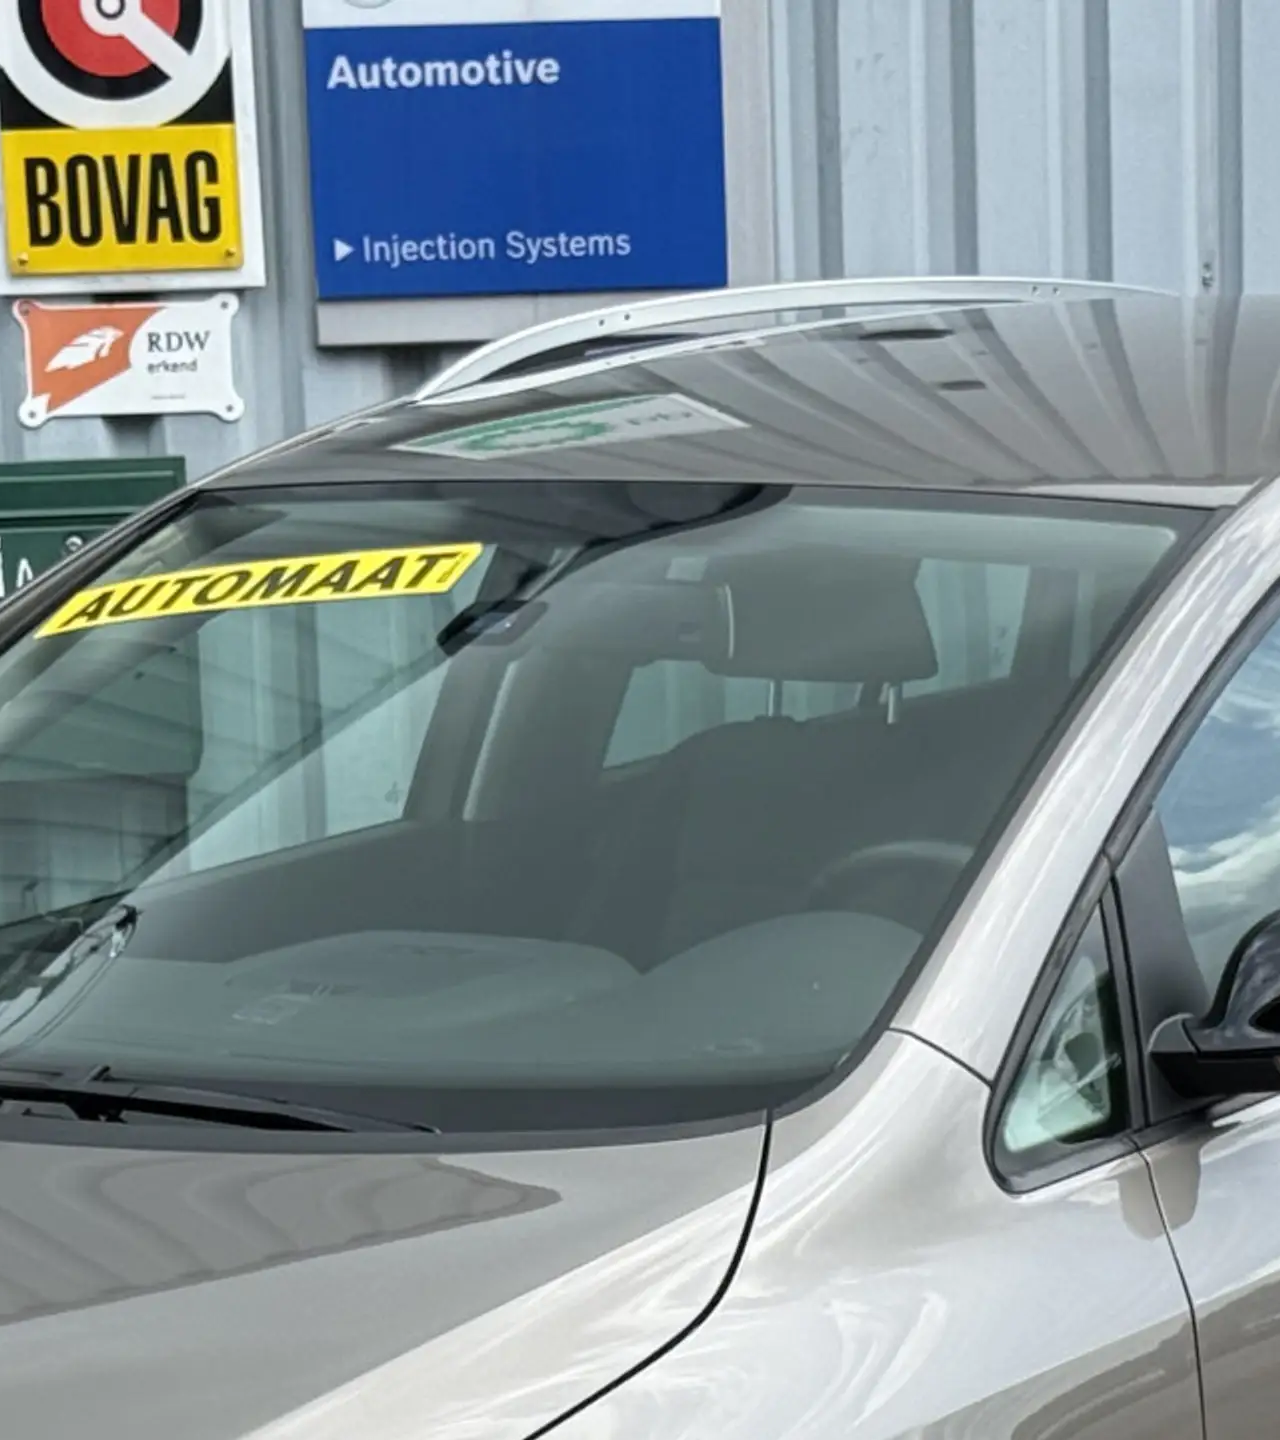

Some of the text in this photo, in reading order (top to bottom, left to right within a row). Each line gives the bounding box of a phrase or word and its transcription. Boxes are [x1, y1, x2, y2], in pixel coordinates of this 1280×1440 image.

[327, 51, 561, 90] Automotive
[23, 150, 222, 248] BOVAG
[363, 231, 631, 268] Injection Systems
[147, 330, 211, 352] RDW
[147, 358, 198, 374] erkend
[57, 551, 459, 628] AUTOMAAT
